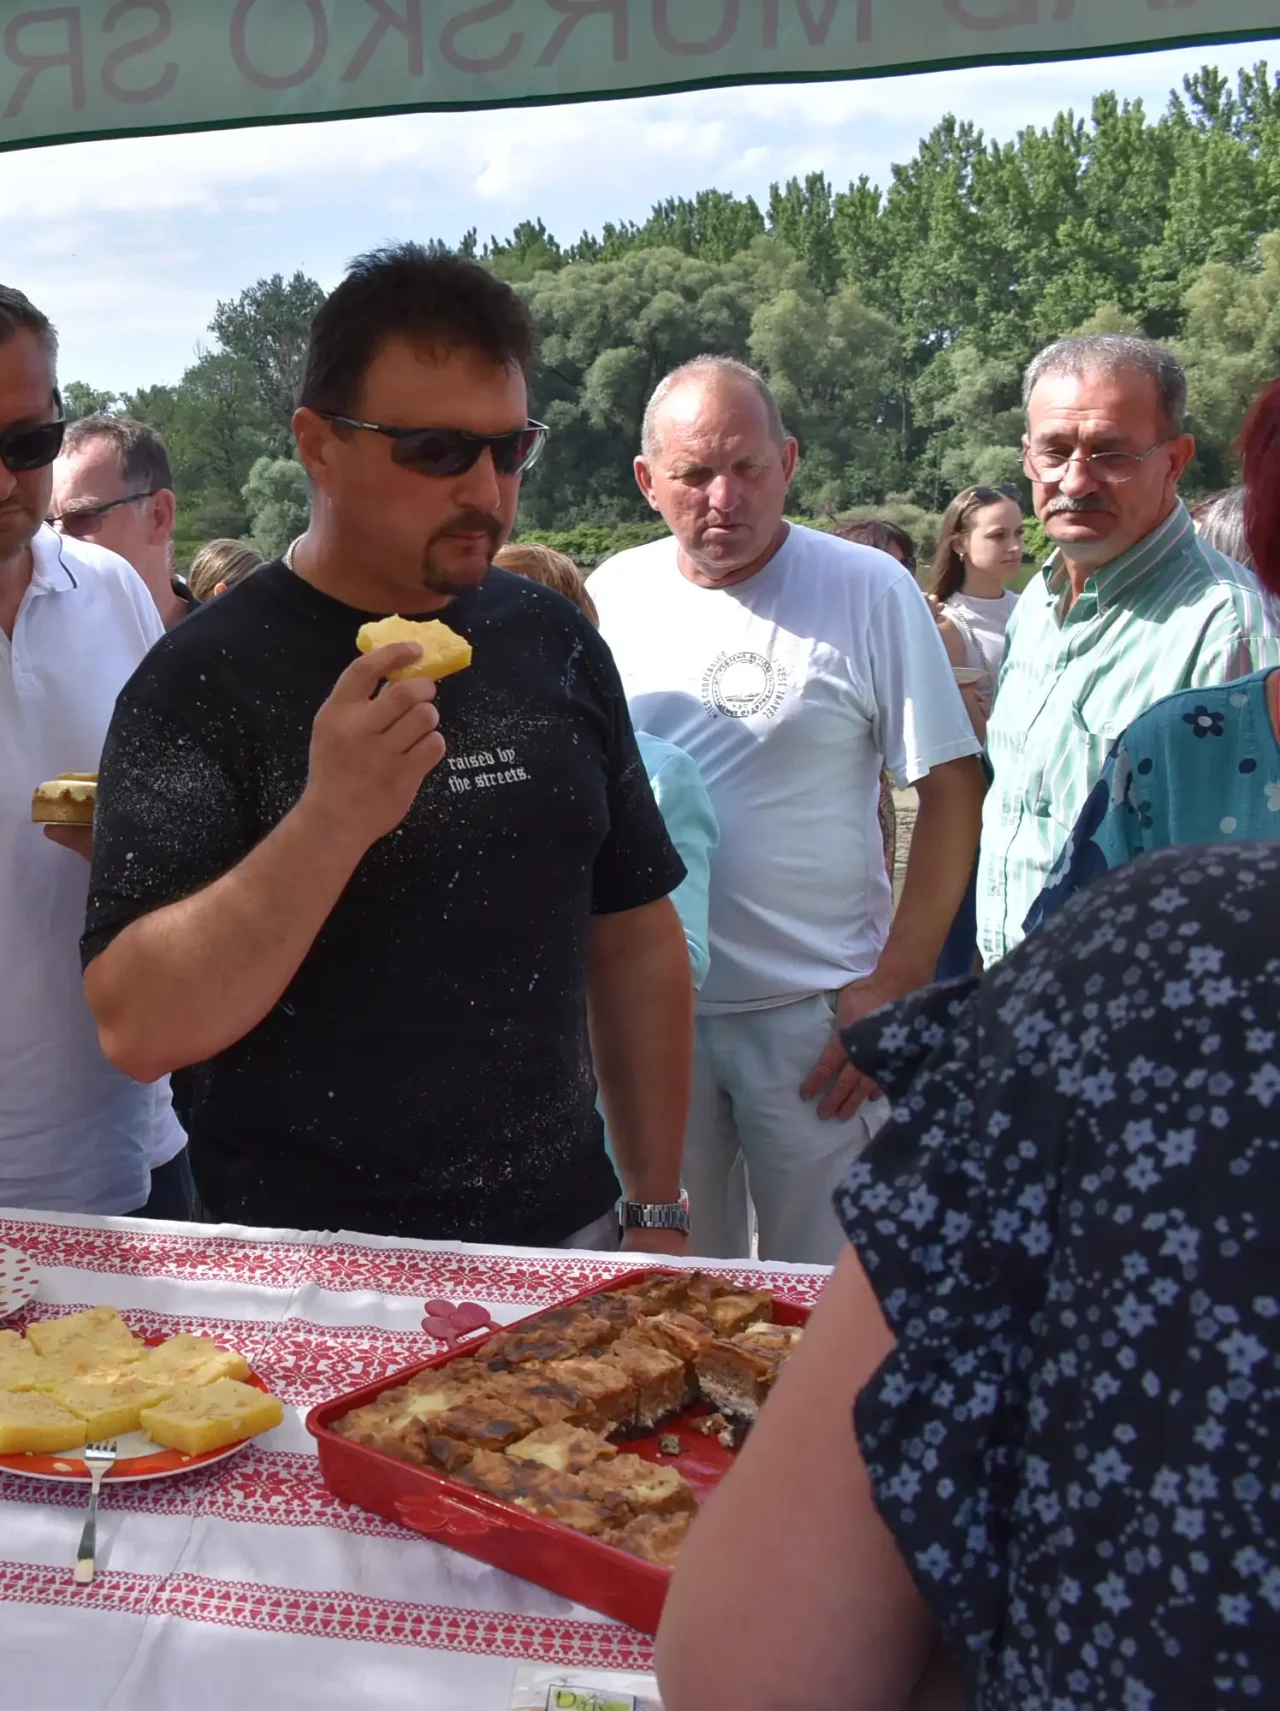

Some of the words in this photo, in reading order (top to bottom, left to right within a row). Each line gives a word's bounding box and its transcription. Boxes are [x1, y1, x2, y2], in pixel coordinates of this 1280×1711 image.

[447, 750, 495, 770] raised
[496, 747, 515, 764] by
[448, 775, 472, 794] the
[474, 766, 531, 788] streets.
